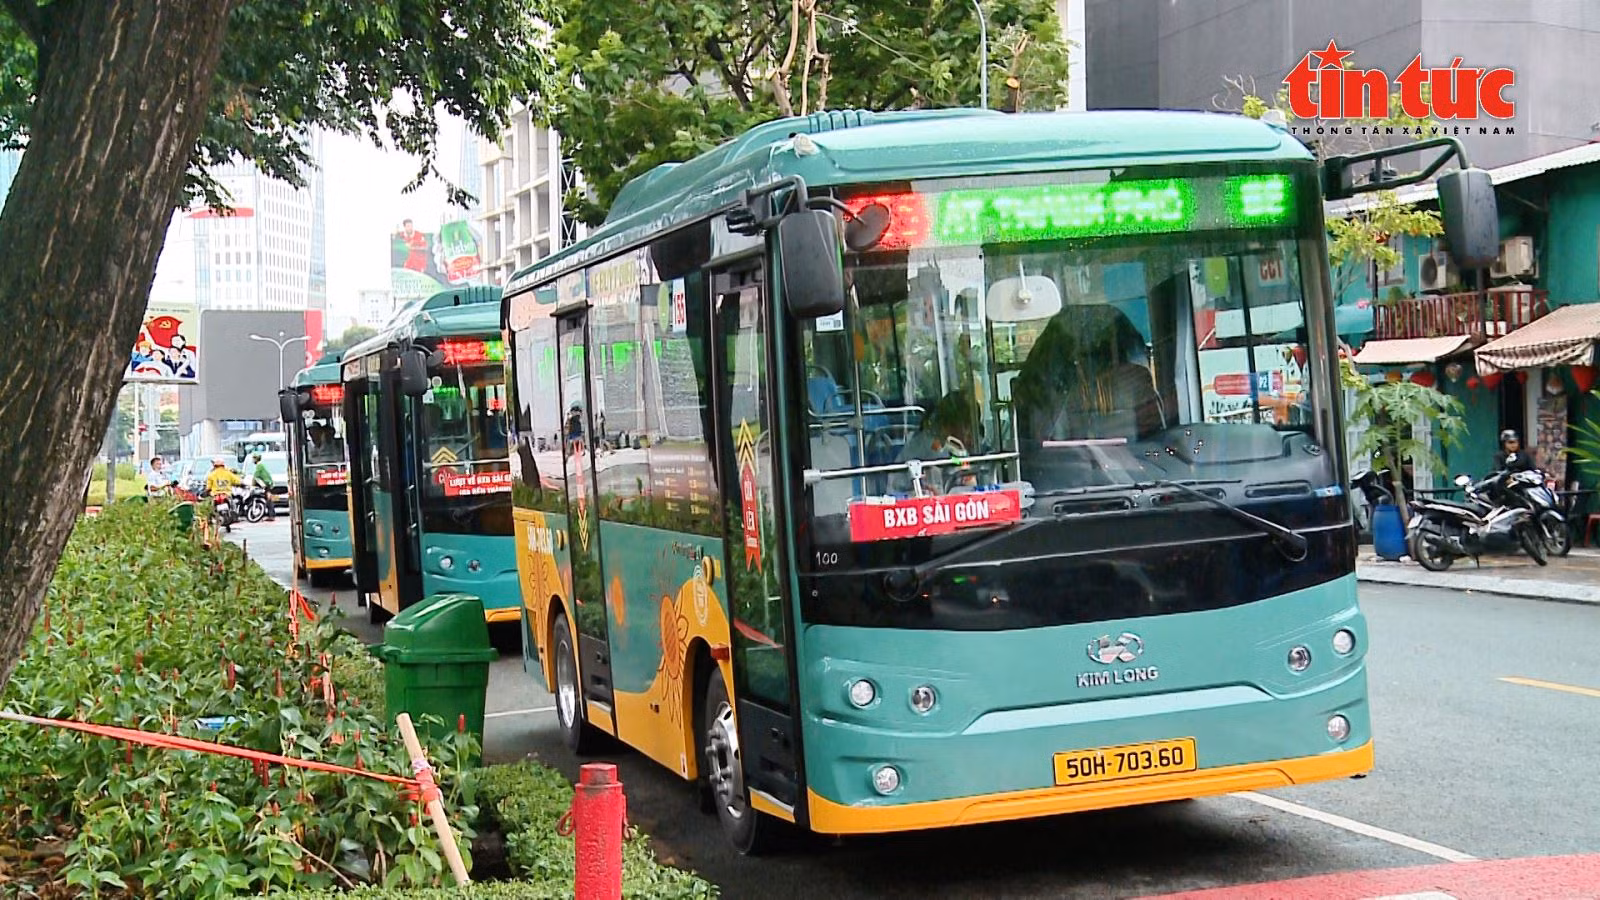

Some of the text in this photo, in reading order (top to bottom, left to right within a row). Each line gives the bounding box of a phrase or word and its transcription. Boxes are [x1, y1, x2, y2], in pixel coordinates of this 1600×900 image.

[883, 498, 990, 529] BXB SÀI GÒN
[815, 551, 838, 565] 100
[1076, 665, 1159, 688] KIM LONG
[1066, 746, 1184, 779] 50H-703.60
